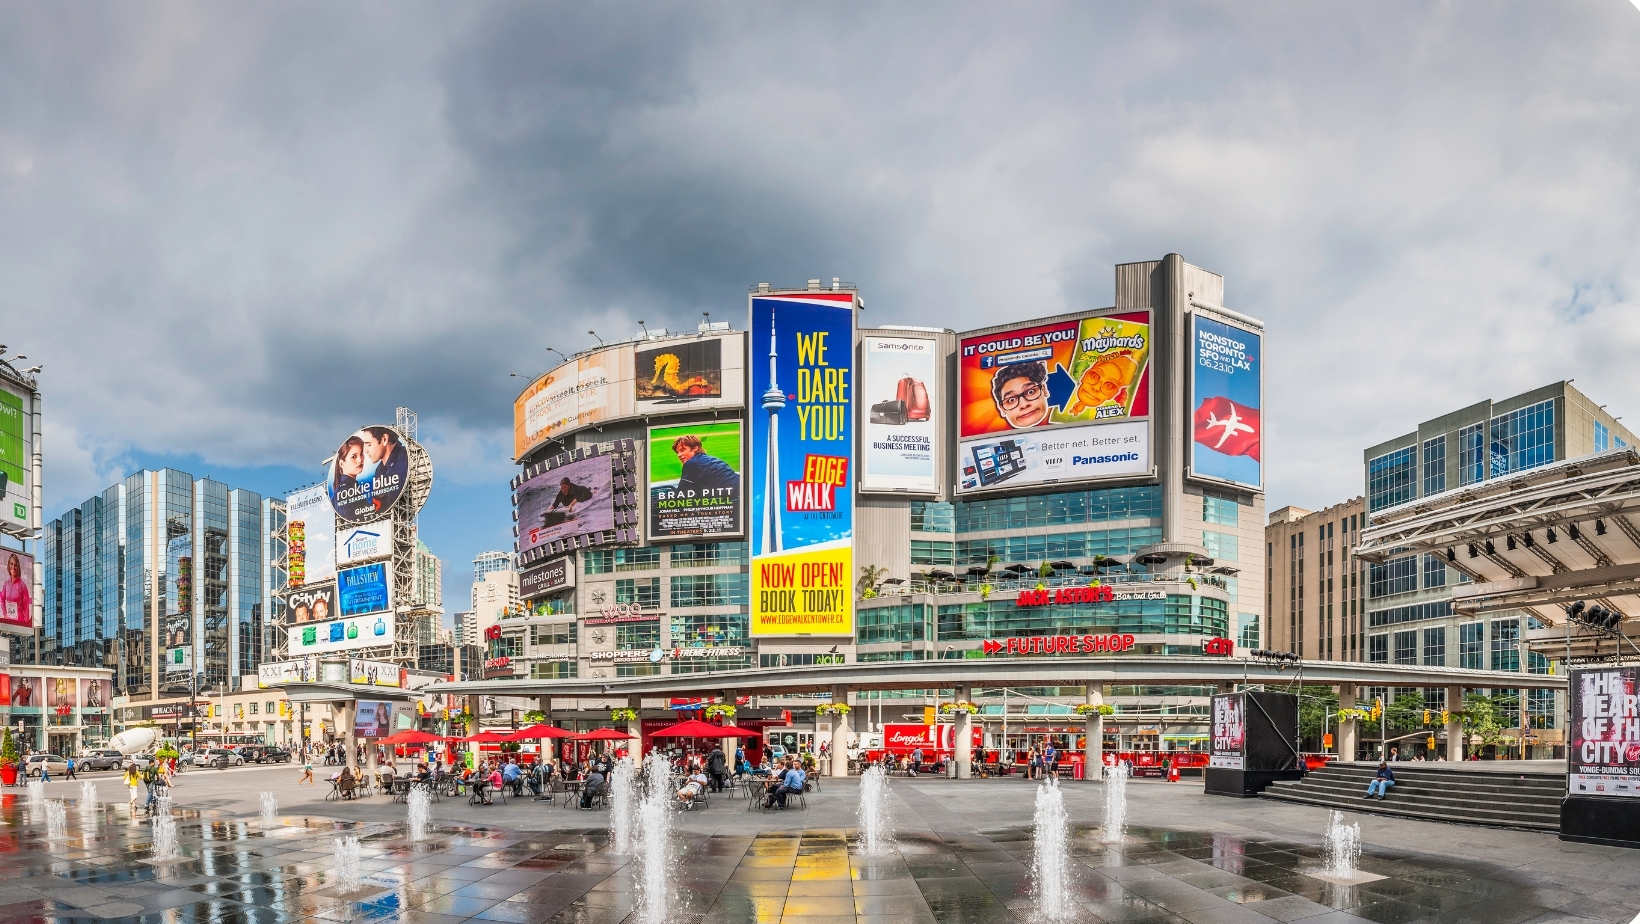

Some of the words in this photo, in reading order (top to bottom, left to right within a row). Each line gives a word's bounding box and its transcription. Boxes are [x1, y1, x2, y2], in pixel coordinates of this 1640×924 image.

[796, 332, 828, 366] WE
[878, 342, 924, 350] Samsonite
[964, 344, 976, 356] IT
[978, 338, 1021, 354] COULD
[1024, 335, 1042, 346] BE
[1044, 330, 1075, 344] YOU!
[1200, 330, 1246, 350] NONSTOP
[1199, 339, 1246, 360] TORONTO
[1200, 349, 1218, 360] SFO
[1220, 355, 1230, 363] AND
[1232, 357, 1250, 371] LAX
[1200, 358, 1234, 374] 06.23.10
[798, 368, 849, 403] DARE
[796, 405, 844, 441] YOU!
[1096, 408, 1124, 420] ALEX
[874, 442, 902, 450] BUSINESS
[904, 443, 930, 452] MEETING
[892, 435, 930, 444] SUCCESSFUL
[1041, 442, 1069, 452] Better
[1072, 439, 1089, 448] net.
[1092, 438, 1120, 446] Better
[1124, 435, 1141, 444] set.
[1072, 451, 1138, 466] Panasonic
[806, 456, 846, 485] EDGE
[336, 482, 370, 501] rookie
[372, 474, 400, 490] blue
[658, 489, 696, 500] BRAD
[702, 487, 733, 497] PITT
[788, 482, 832, 510] WALK
[354, 504, 376, 516] Global
[658, 496, 733, 508] MONEYBALL
[15, 506, 24, 517] TD
[352, 538, 378, 550] home
[352, 548, 378, 558] services
[346, 571, 379, 587] FALLSVIEW
[522, 566, 564, 588] milestones
[760, 563, 796, 588] NOW
[802, 562, 844, 588] OPEN!
[538, 582, 550, 590] GRILL
[760, 590, 796, 613] BOOK
[802, 590, 844, 613] TODAY!
[1015, 588, 1050, 606] JACK
[1054, 585, 1114, 604] ASTOR'S
[760, 614, 844, 624] WWW.EDGEWALKCNTOWER.CA
[592, 650, 648, 659] SHOPPERS
[706, 648, 742, 657] FITNESS
[1006, 635, 1080, 655] FUTURE
[1082, 634, 1135, 652] SHOP
[1582, 672, 1620, 695] THE
[1582, 694, 1640, 718] HEAR
[1582, 718, 1607, 741] OF
[1214, 737, 1231, 750] CITY
[1582, 740, 1628, 764] CITY
[1579, 766, 1628, 774] YONGE-DUNDAS
